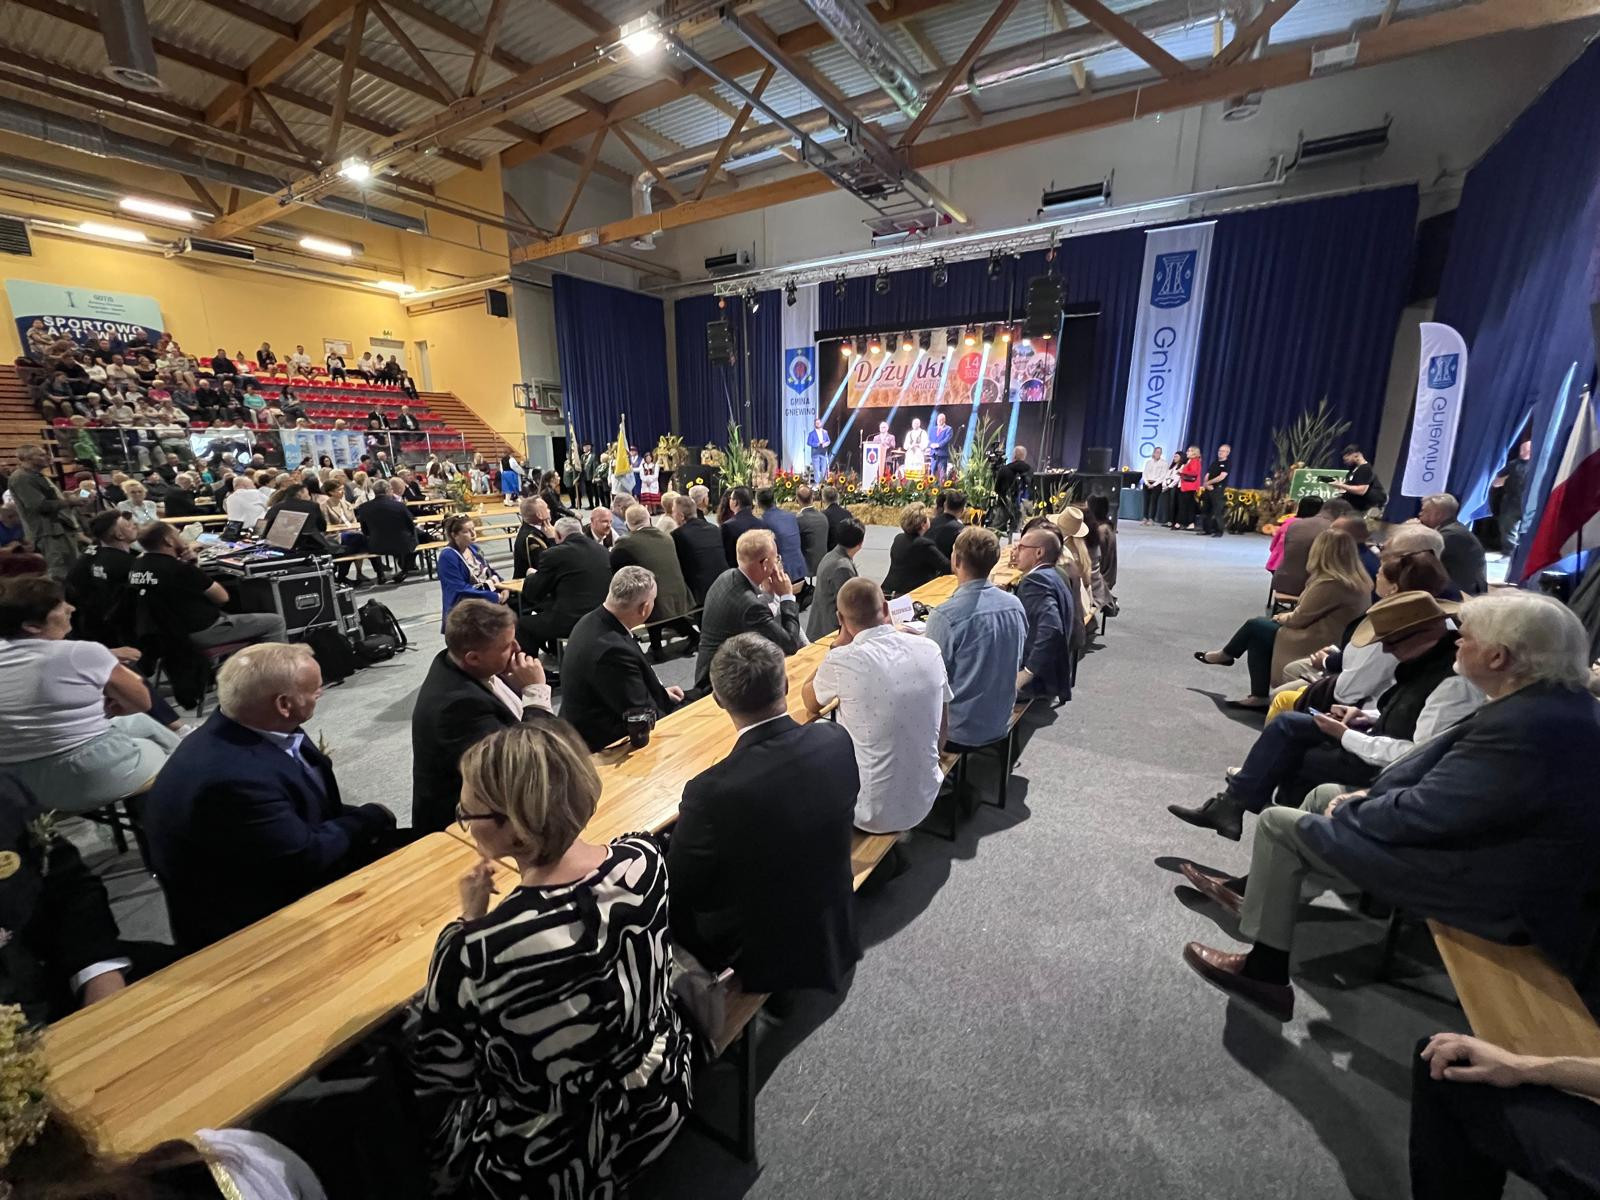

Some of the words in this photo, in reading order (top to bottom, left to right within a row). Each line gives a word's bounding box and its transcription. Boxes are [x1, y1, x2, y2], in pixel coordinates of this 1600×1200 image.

[965, 356, 979, 369] 14
[1139, 326, 1176, 459] Gniewino
[790, 397, 810, 407] GMINA
[785, 408, 816, 417] GNIEWINO
